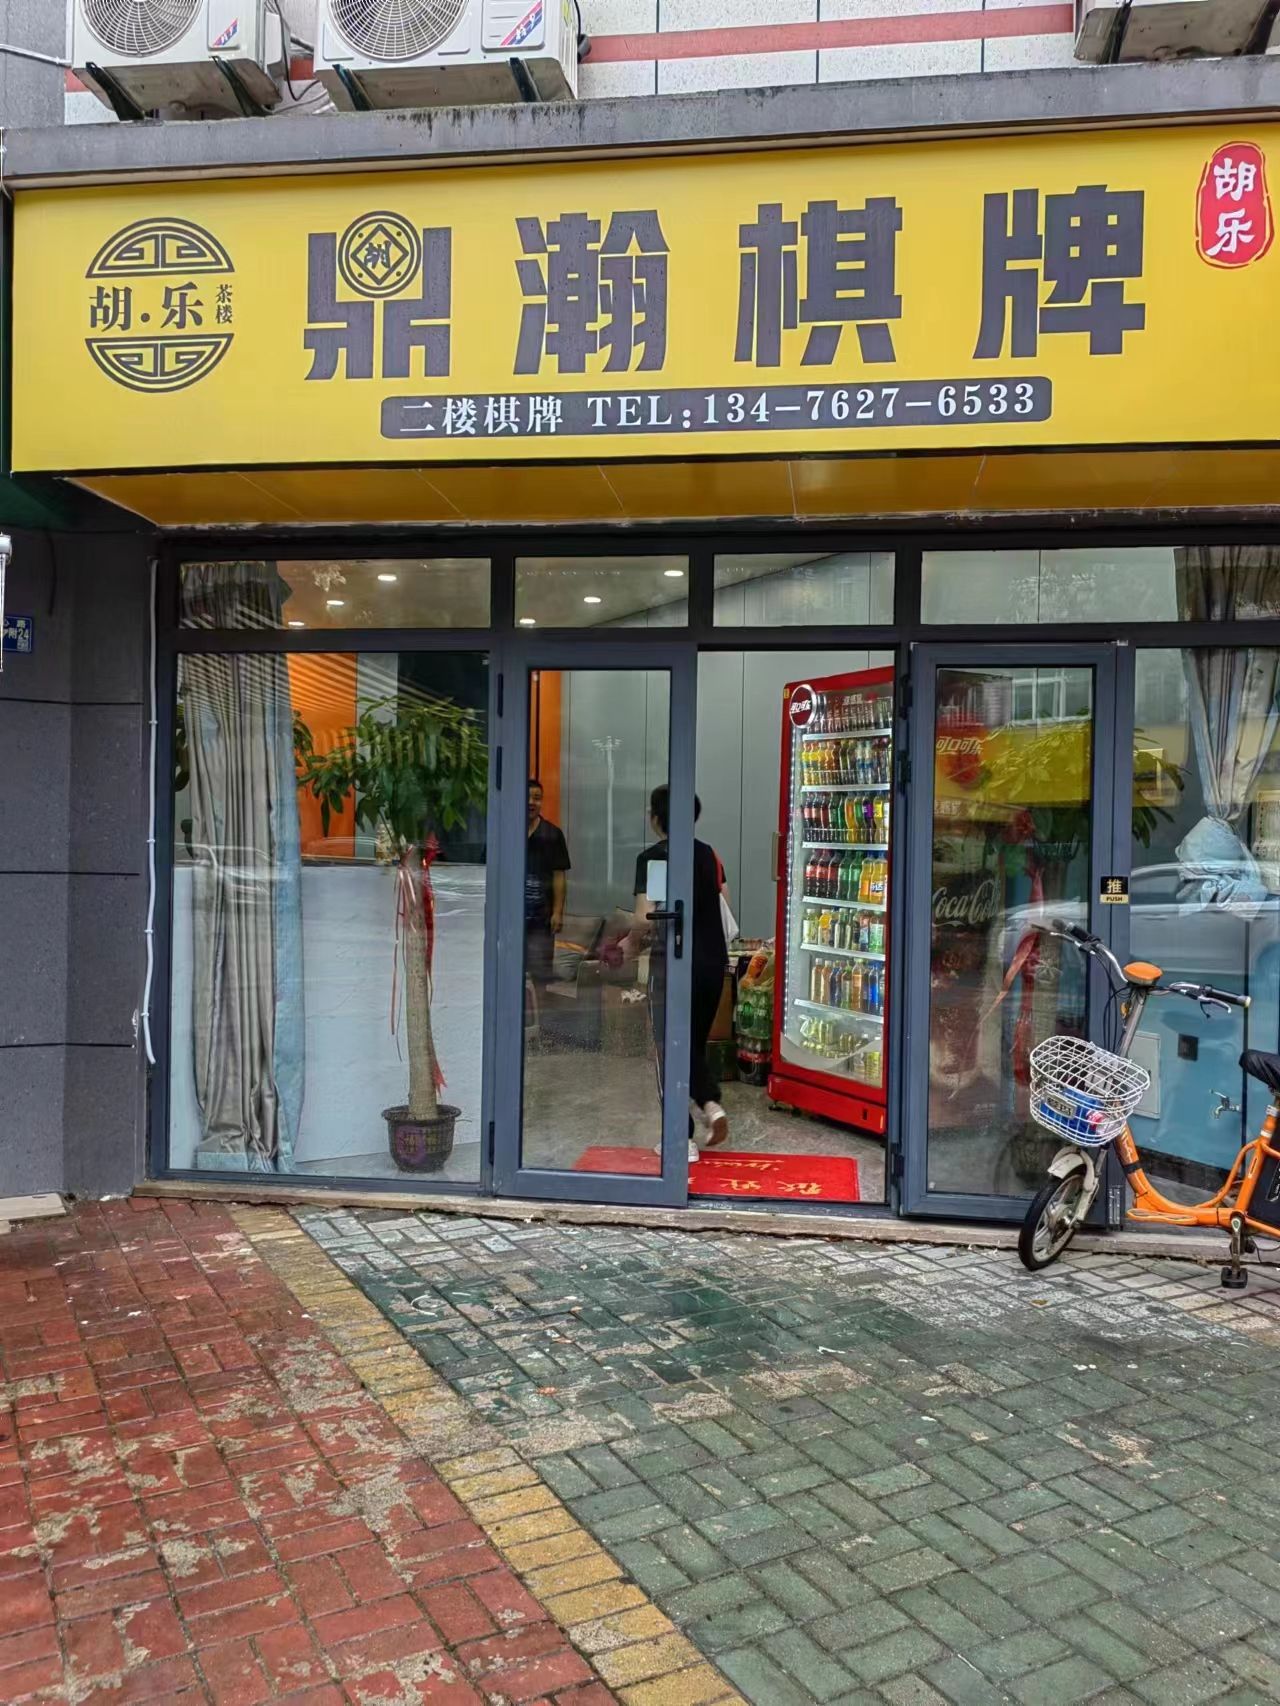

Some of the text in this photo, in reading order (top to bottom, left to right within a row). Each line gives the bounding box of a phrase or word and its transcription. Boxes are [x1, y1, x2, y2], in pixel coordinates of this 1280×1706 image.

[1208, 157, 1255, 258] 胡乐
[304, 184, 1146, 381] 鼎瀚棋牌
[214, 284, 234, 325] 茶楼
[399, 395, 563, 436] 二楼棋牌
[1106, 896, 1123, 904] PUSH
[1107, 878, 1122, 894] 推
